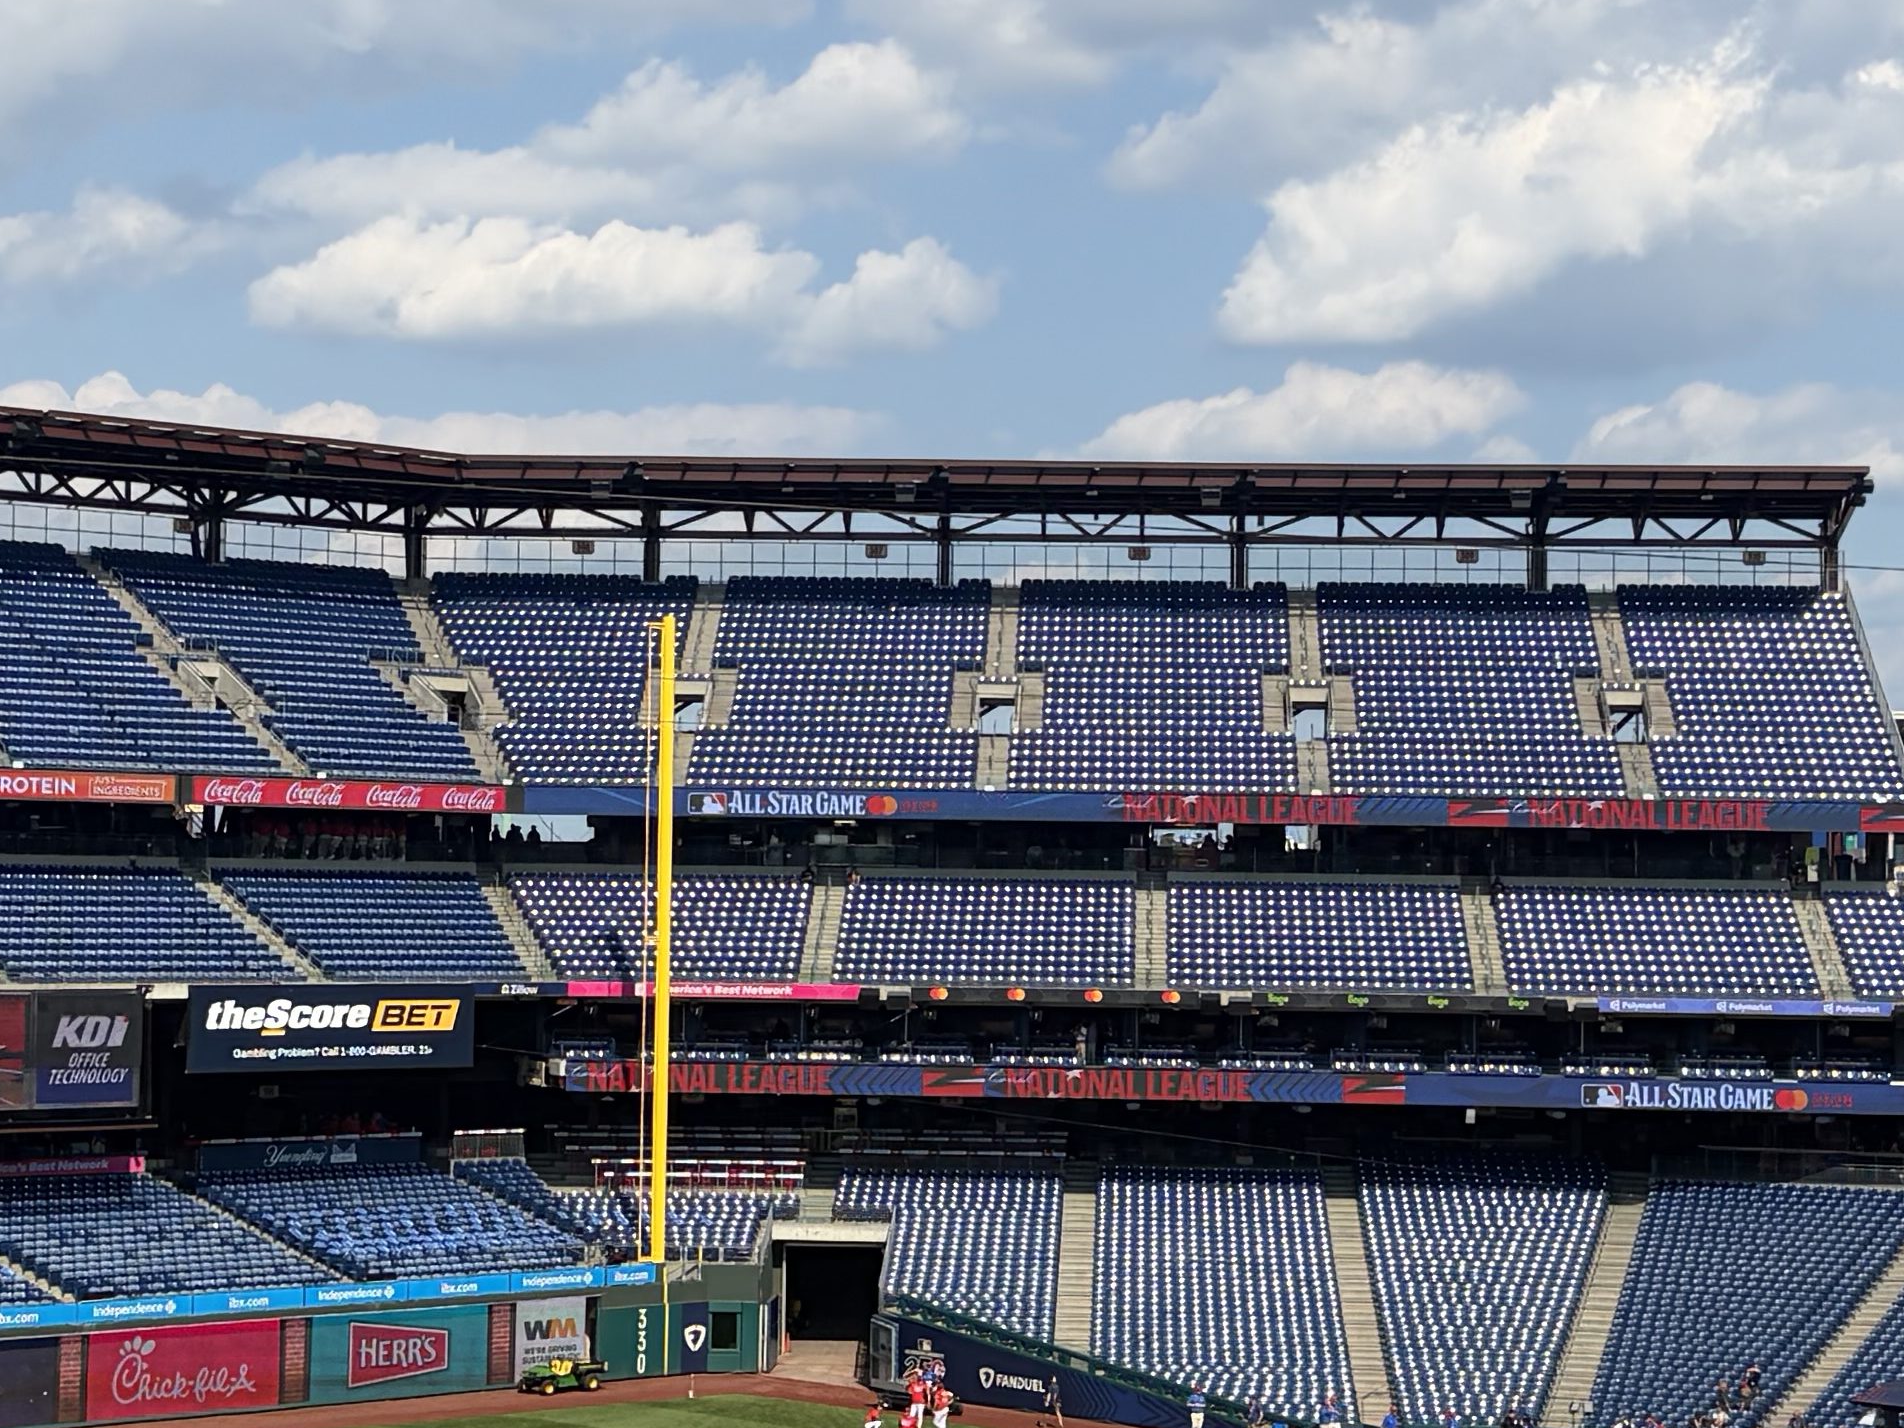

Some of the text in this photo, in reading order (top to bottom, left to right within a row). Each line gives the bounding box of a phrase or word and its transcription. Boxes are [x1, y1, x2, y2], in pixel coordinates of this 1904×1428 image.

[728, 790, 866, 815] ALL STAR GAME
[1259, 795, 1361, 826] LEAGUE
[1666, 800, 1770, 830] LEAGUE
[745, 985, 793, 996] Network
[205, 999, 454, 1032] theScore BET
[52, 1014, 130, 1048] KDI
[68, 1052, 109, 1069] OFFICE
[321, 1046, 339, 1058] Call
[48, 1067, 129, 1086] TECHNOLOGY
[727, 1062, 833, 1094] LEAGUE
[1005, 1067, 1252, 1102] NATIONAL LEAGUE
[1625, 1082, 1775, 1111] ALL STAR GAME
[57, 1159, 109, 1171] Network
[440, 1281, 477, 1296] ibx.com
[521, 1271, 583, 1288] Independence
[228, 1295, 269, 1310] ibx.com
[317, 1285, 386, 1302] Independence
[92, 1301, 166, 1318] Independence
[524, 1317, 578, 1341] WM
[358, 1334, 438, 1368] HERR'S
[995, 1373, 1046, 1393] FANDUEL
